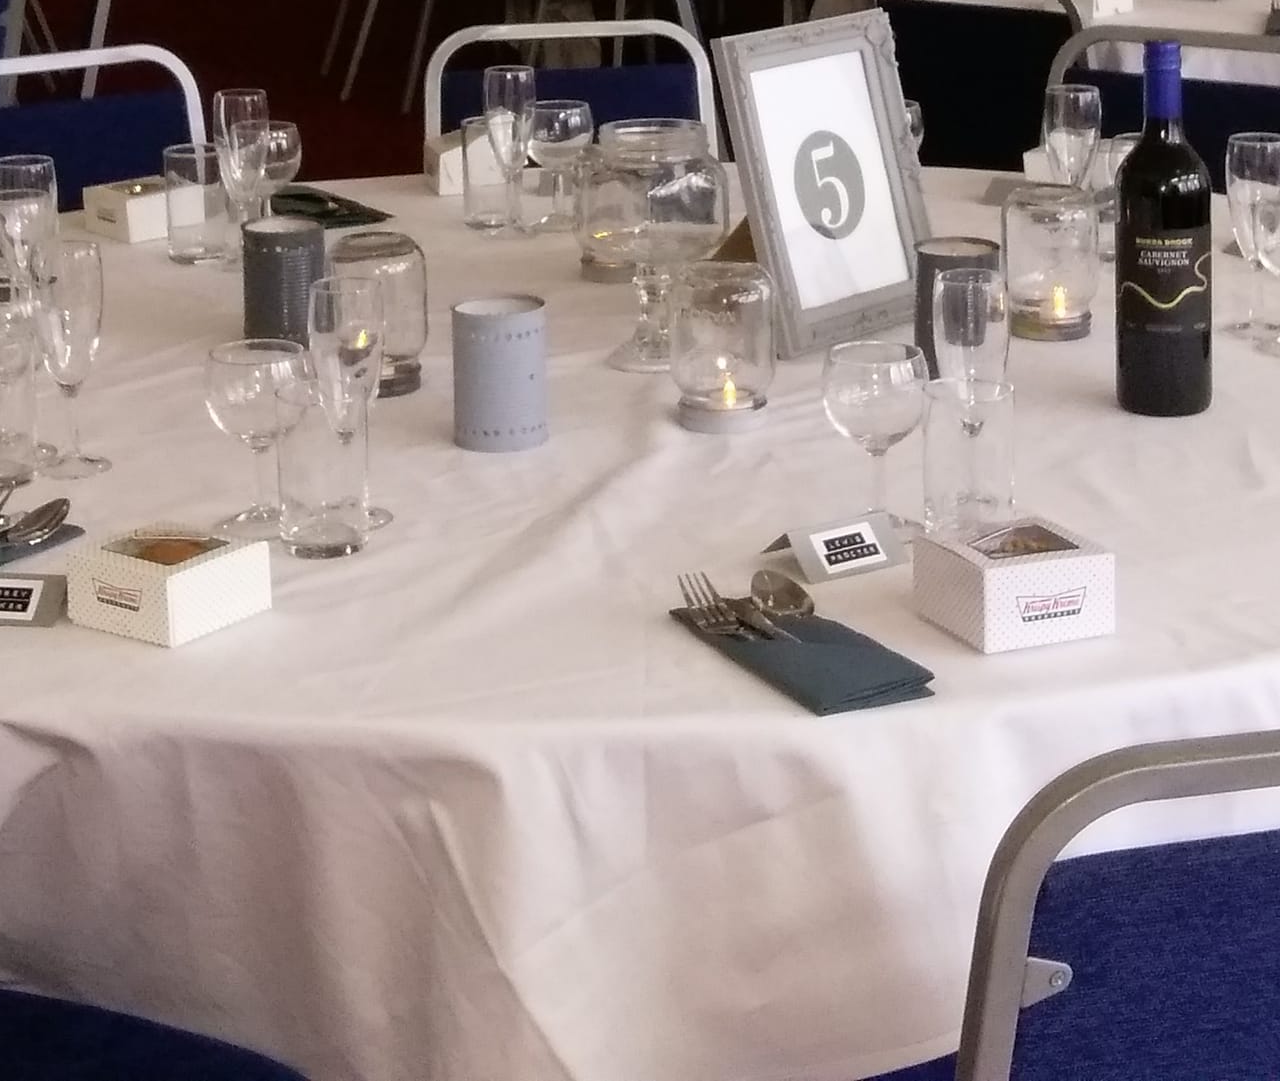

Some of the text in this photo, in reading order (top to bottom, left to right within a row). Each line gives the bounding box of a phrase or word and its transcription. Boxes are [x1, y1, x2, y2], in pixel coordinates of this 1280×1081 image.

[811, 139, 849, 228] 5
[1140, 250, 1188, 260] CABERNET
[1137, 258, 1190, 267] SAUVIGNON
